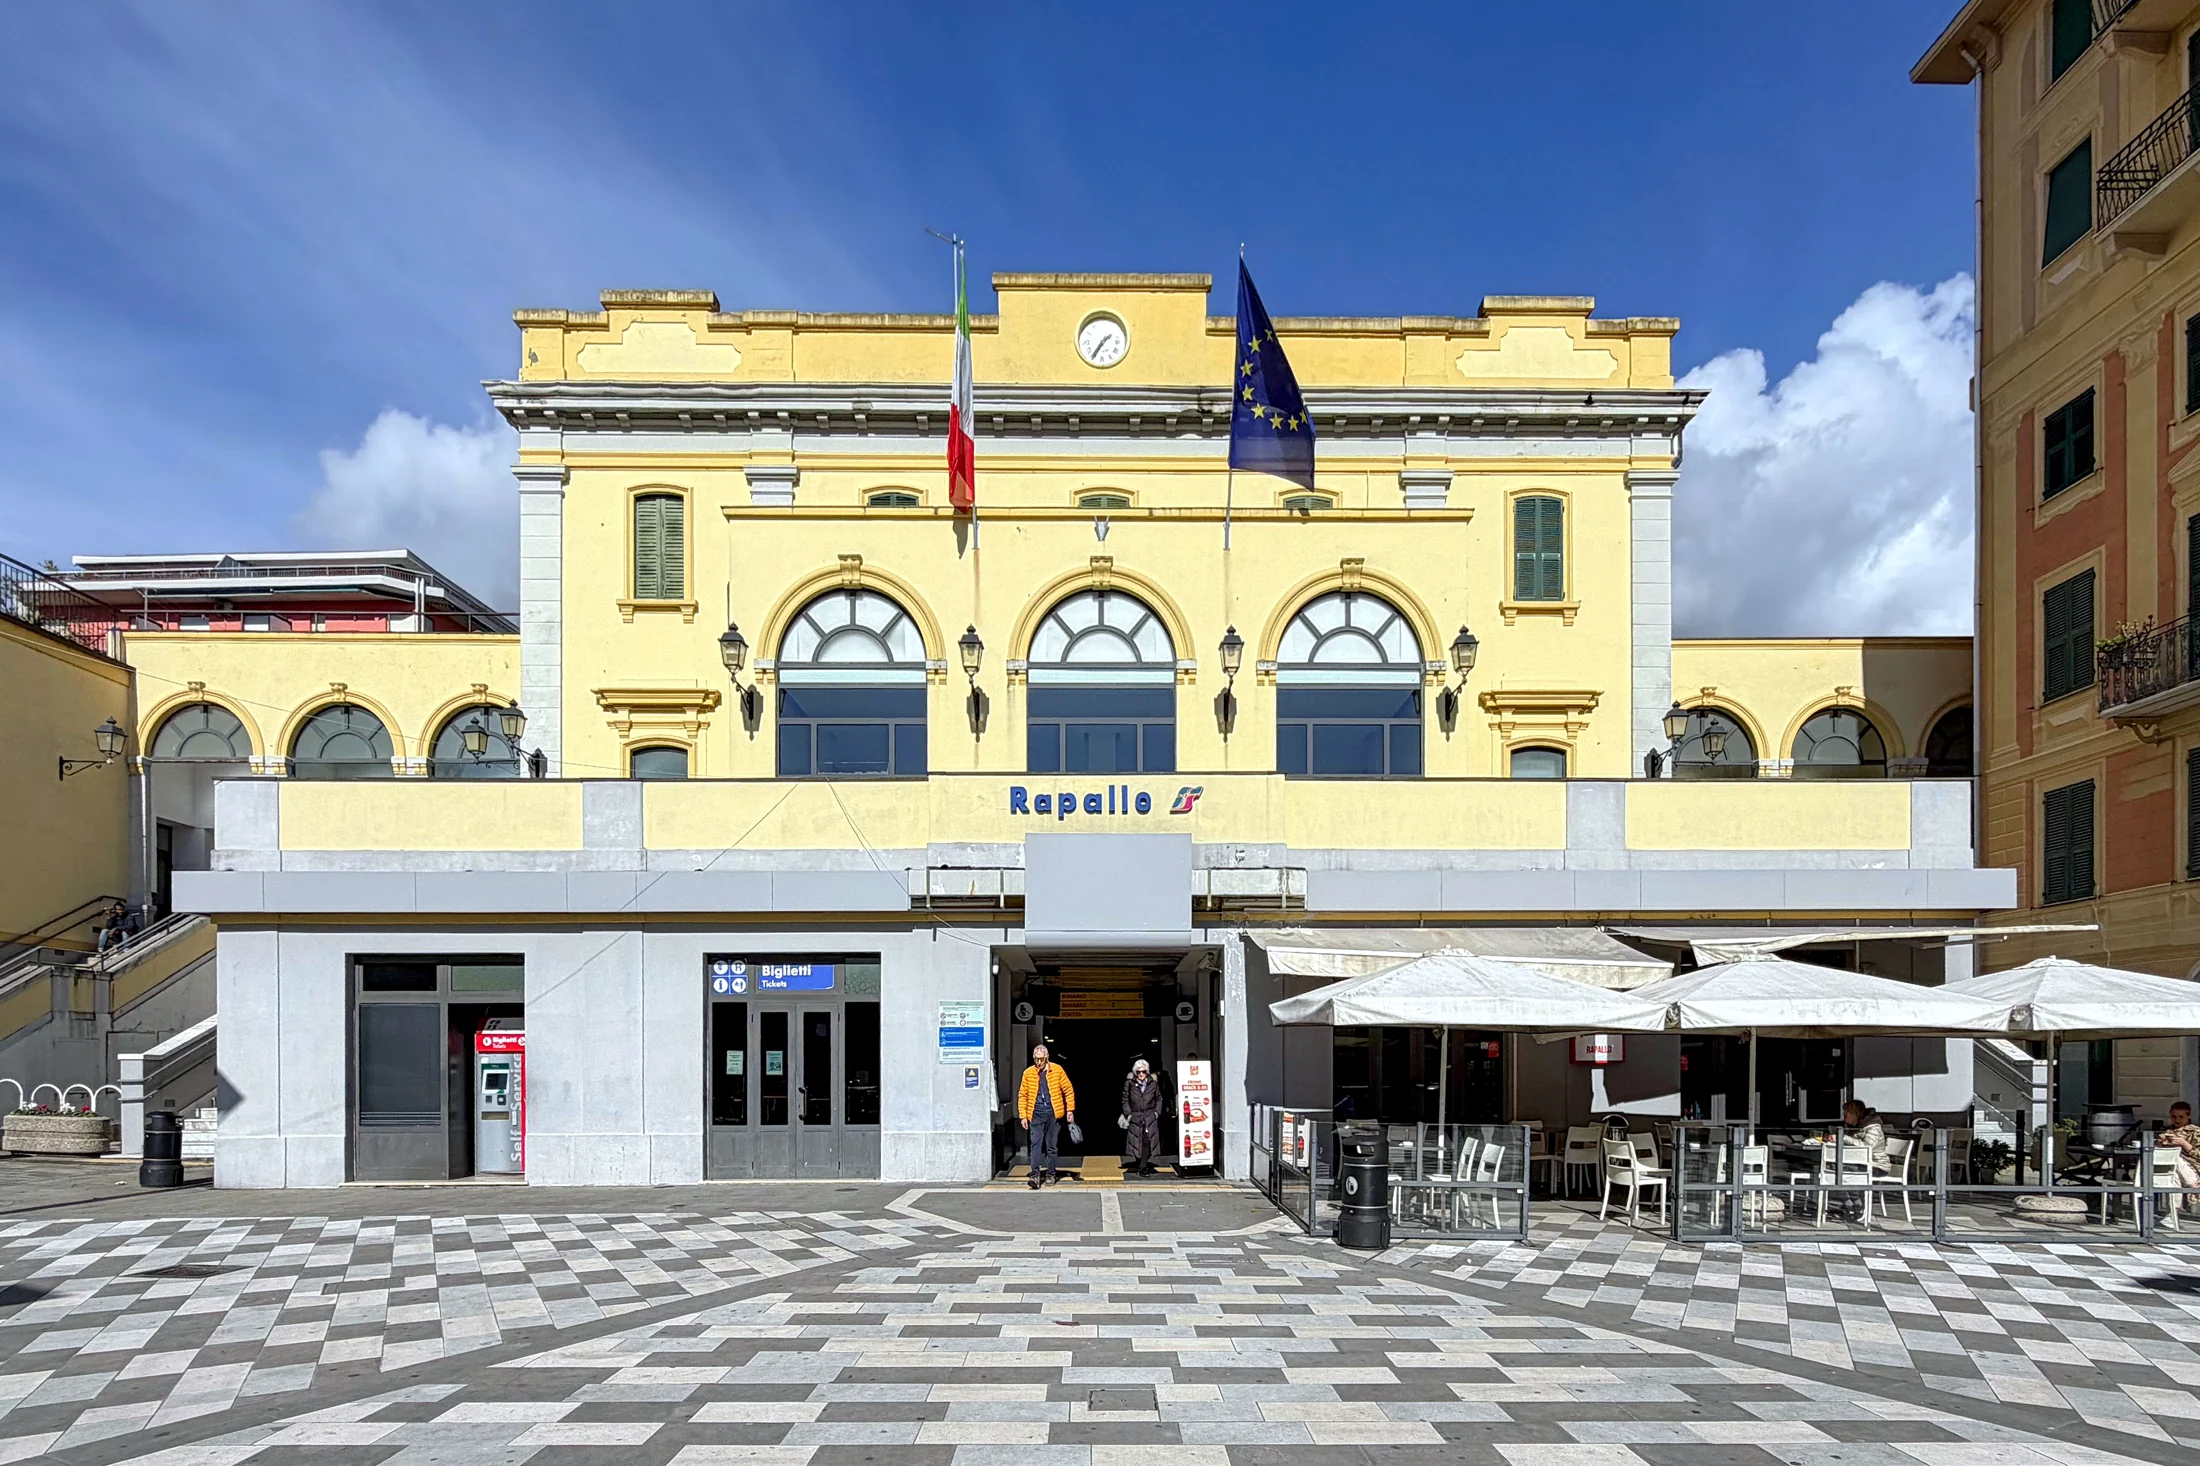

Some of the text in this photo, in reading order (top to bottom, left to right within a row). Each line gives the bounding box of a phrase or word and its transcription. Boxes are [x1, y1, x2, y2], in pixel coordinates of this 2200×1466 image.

[1010, 784, 1152, 821] Rapallo
[762, 964, 812, 978] Biglietti
[762, 980, 787, 988] Tickets
[1586, 1045, 1612, 1054] RAPALLO
